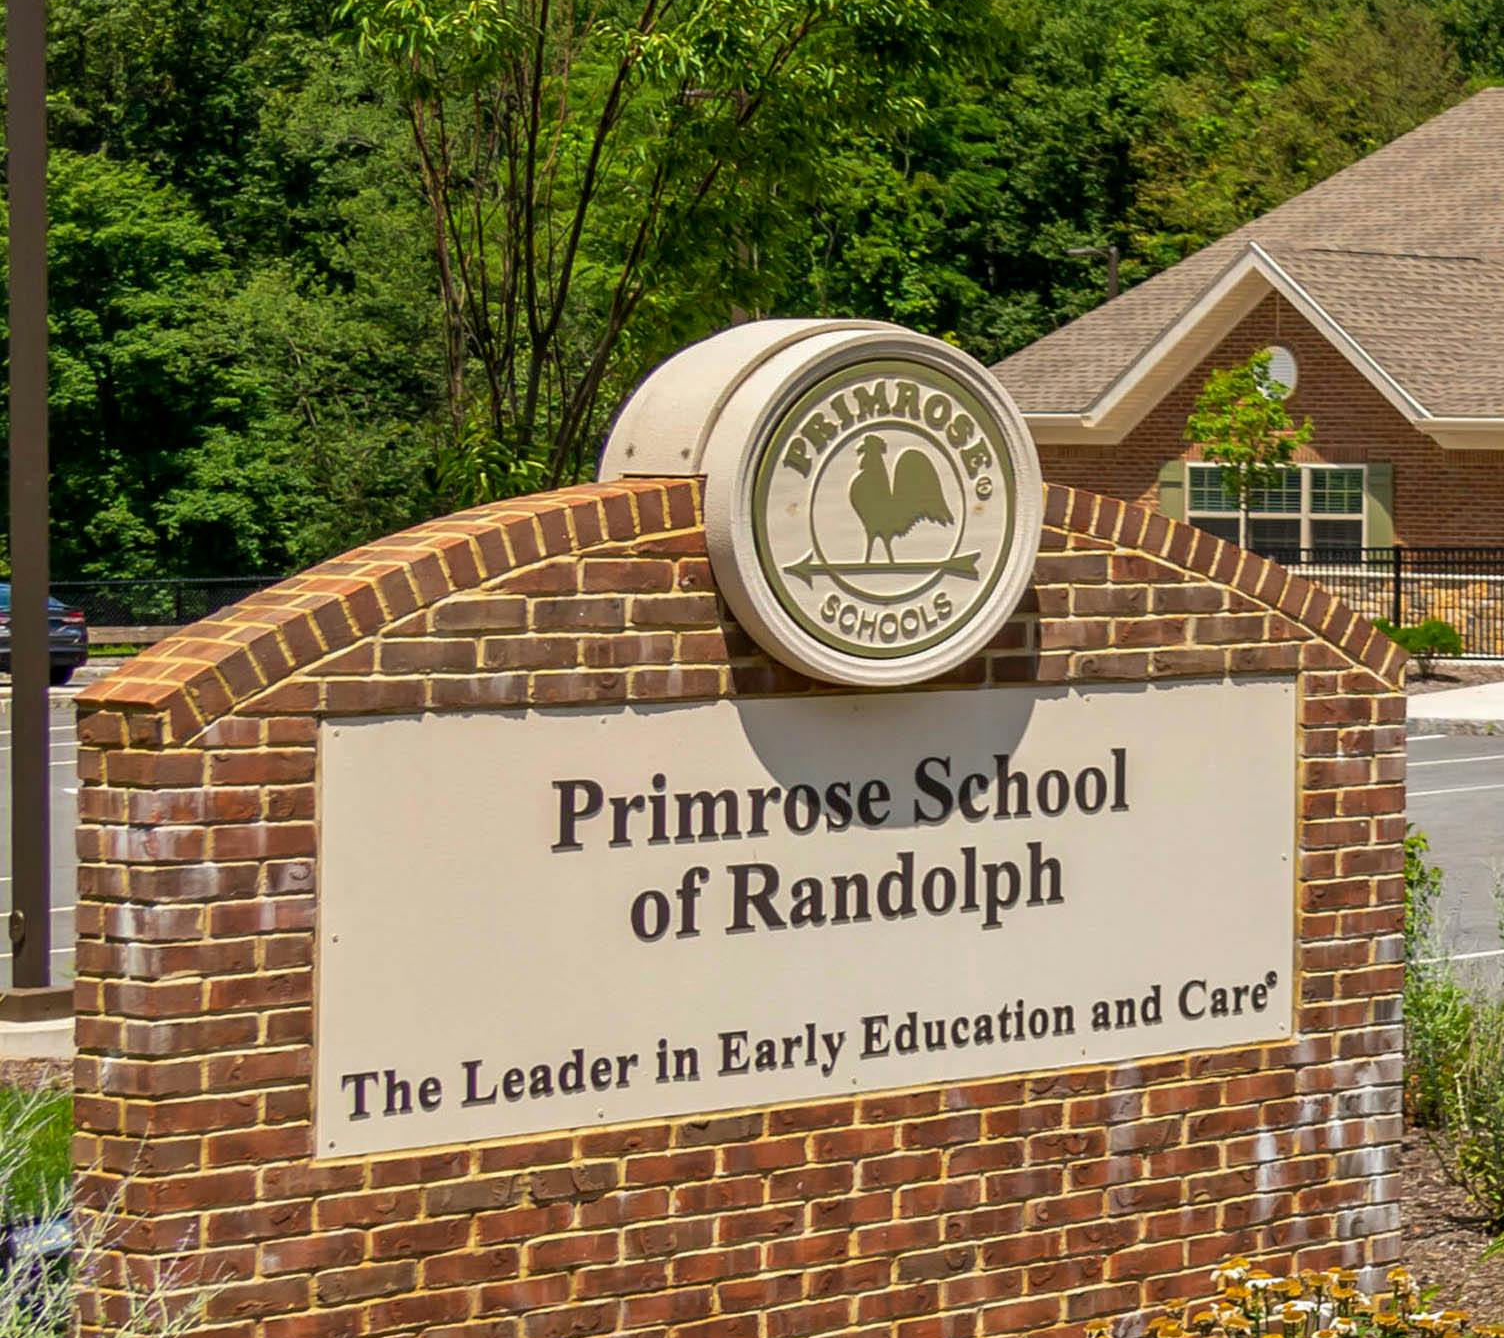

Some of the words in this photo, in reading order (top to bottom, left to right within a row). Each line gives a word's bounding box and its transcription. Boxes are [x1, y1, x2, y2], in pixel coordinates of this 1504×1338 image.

[820, 591, 953, 643] SCHOOLS
[551, 772, 891, 853] Primrose
[912, 747, 1130, 827] School
[630, 865, 710, 942] of
[725, 842, 1066, 935] Randolph
[342, 1069, 443, 1121] The
[461, 1049, 639, 1107] Leader
[655, 1038, 701, 1084] in
[718, 1023, 847, 1077] Early
[860, 1000, 1076, 1060] Education
[1091, 986, 1162, 1030] and
